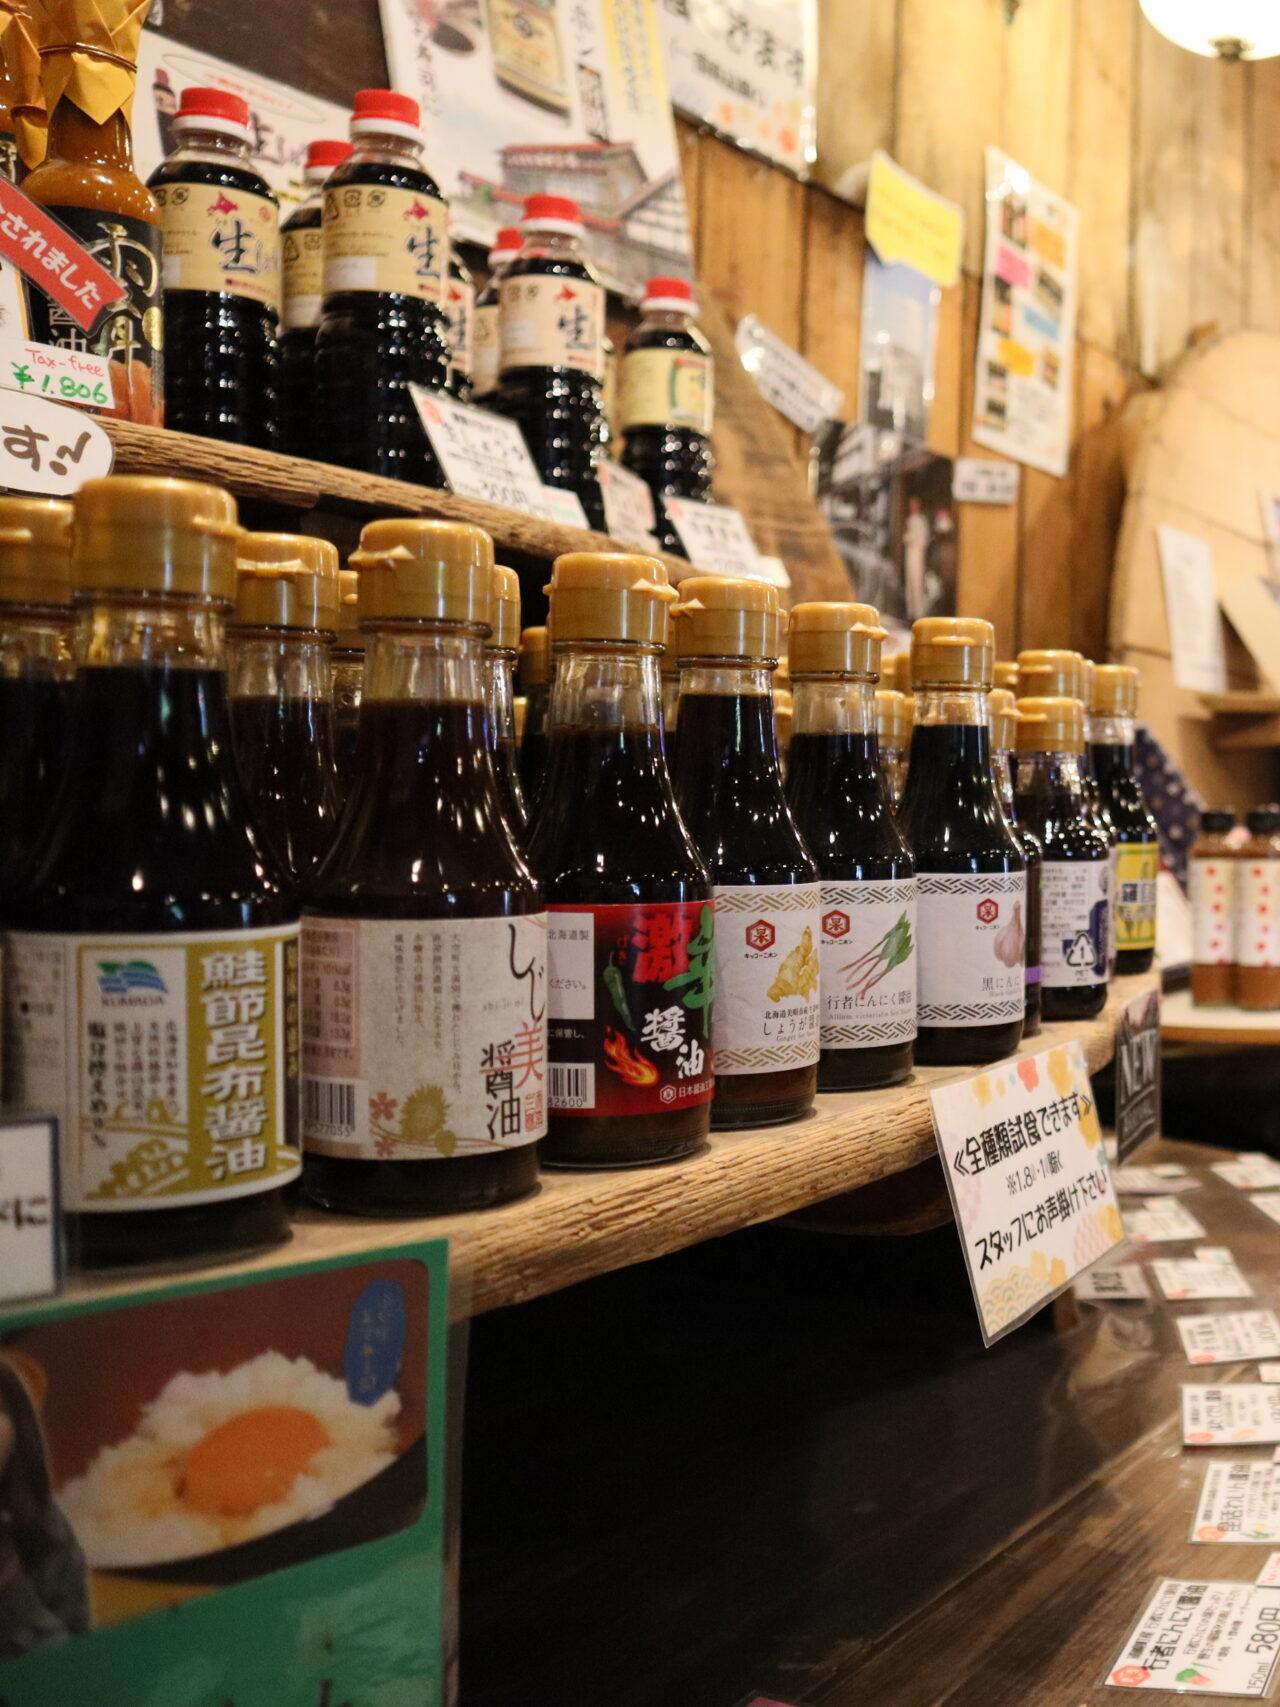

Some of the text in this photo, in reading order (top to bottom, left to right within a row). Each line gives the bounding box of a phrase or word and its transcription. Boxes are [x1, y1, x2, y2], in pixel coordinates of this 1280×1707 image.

[0, 203, 101, 310] されました
[24, 348, 104, 377] Tax-free
[1142, 1584, 1209, 1671] 行者にんにく醤油
